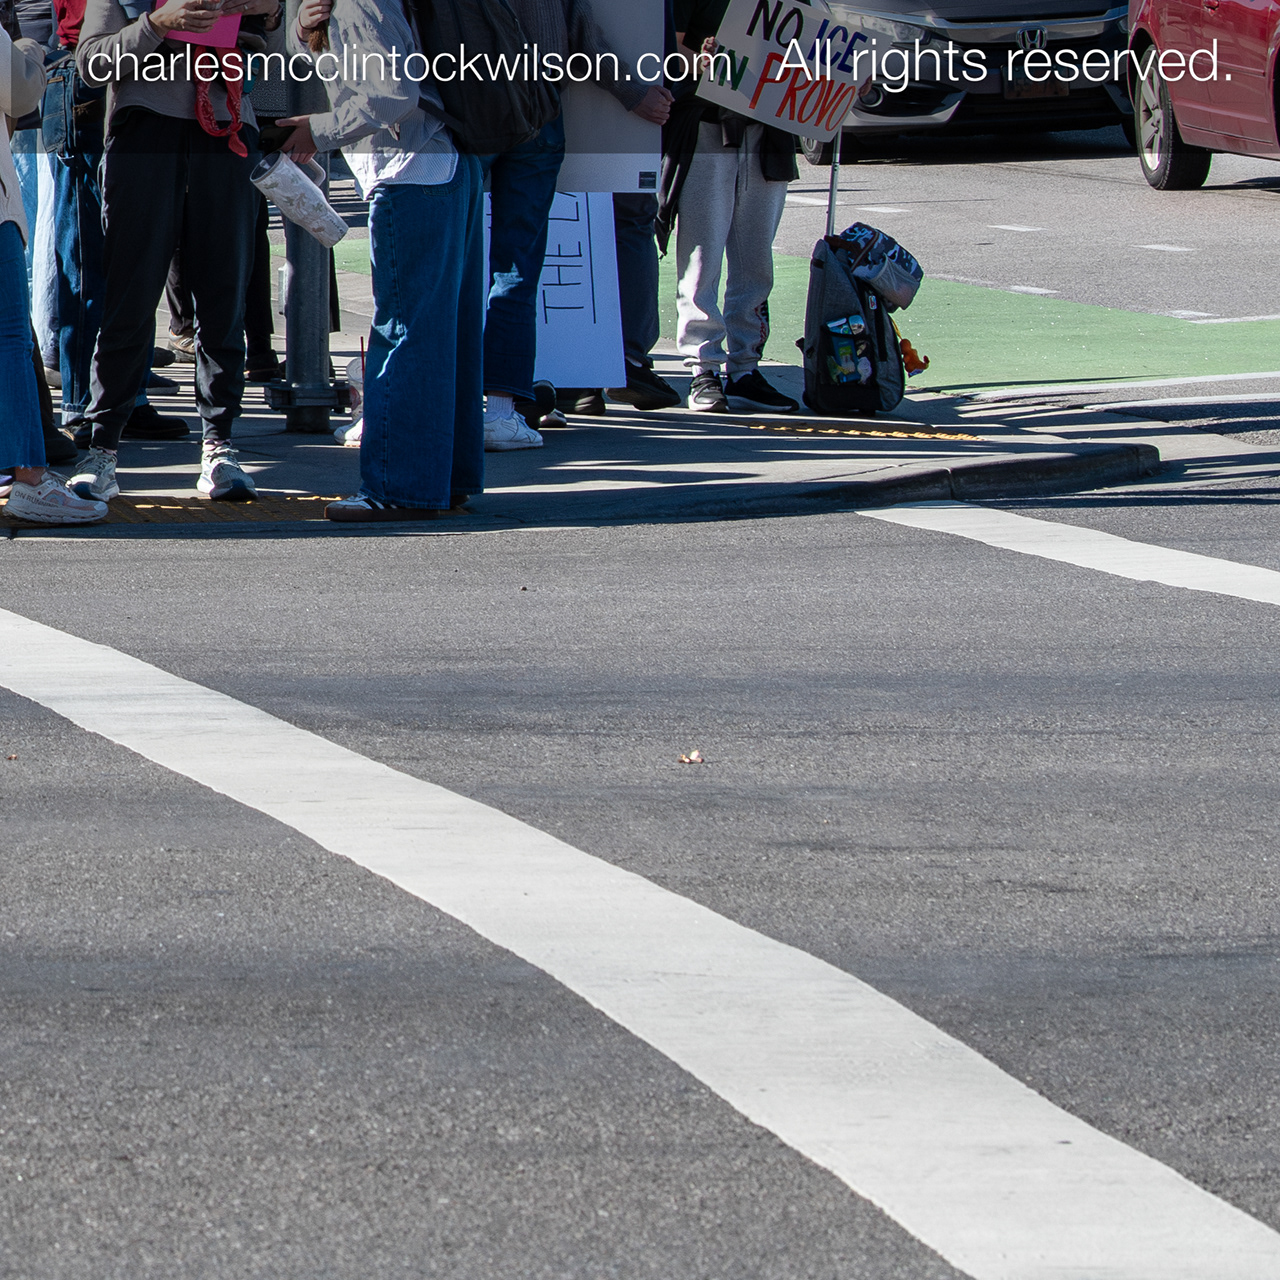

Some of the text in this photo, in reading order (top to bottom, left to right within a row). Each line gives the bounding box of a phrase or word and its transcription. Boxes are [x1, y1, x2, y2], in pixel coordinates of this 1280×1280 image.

[807, 18, 868, 74] ICE
[708, 45, 857, 132] IN PROVO
[542, 241, 584, 325] THE
